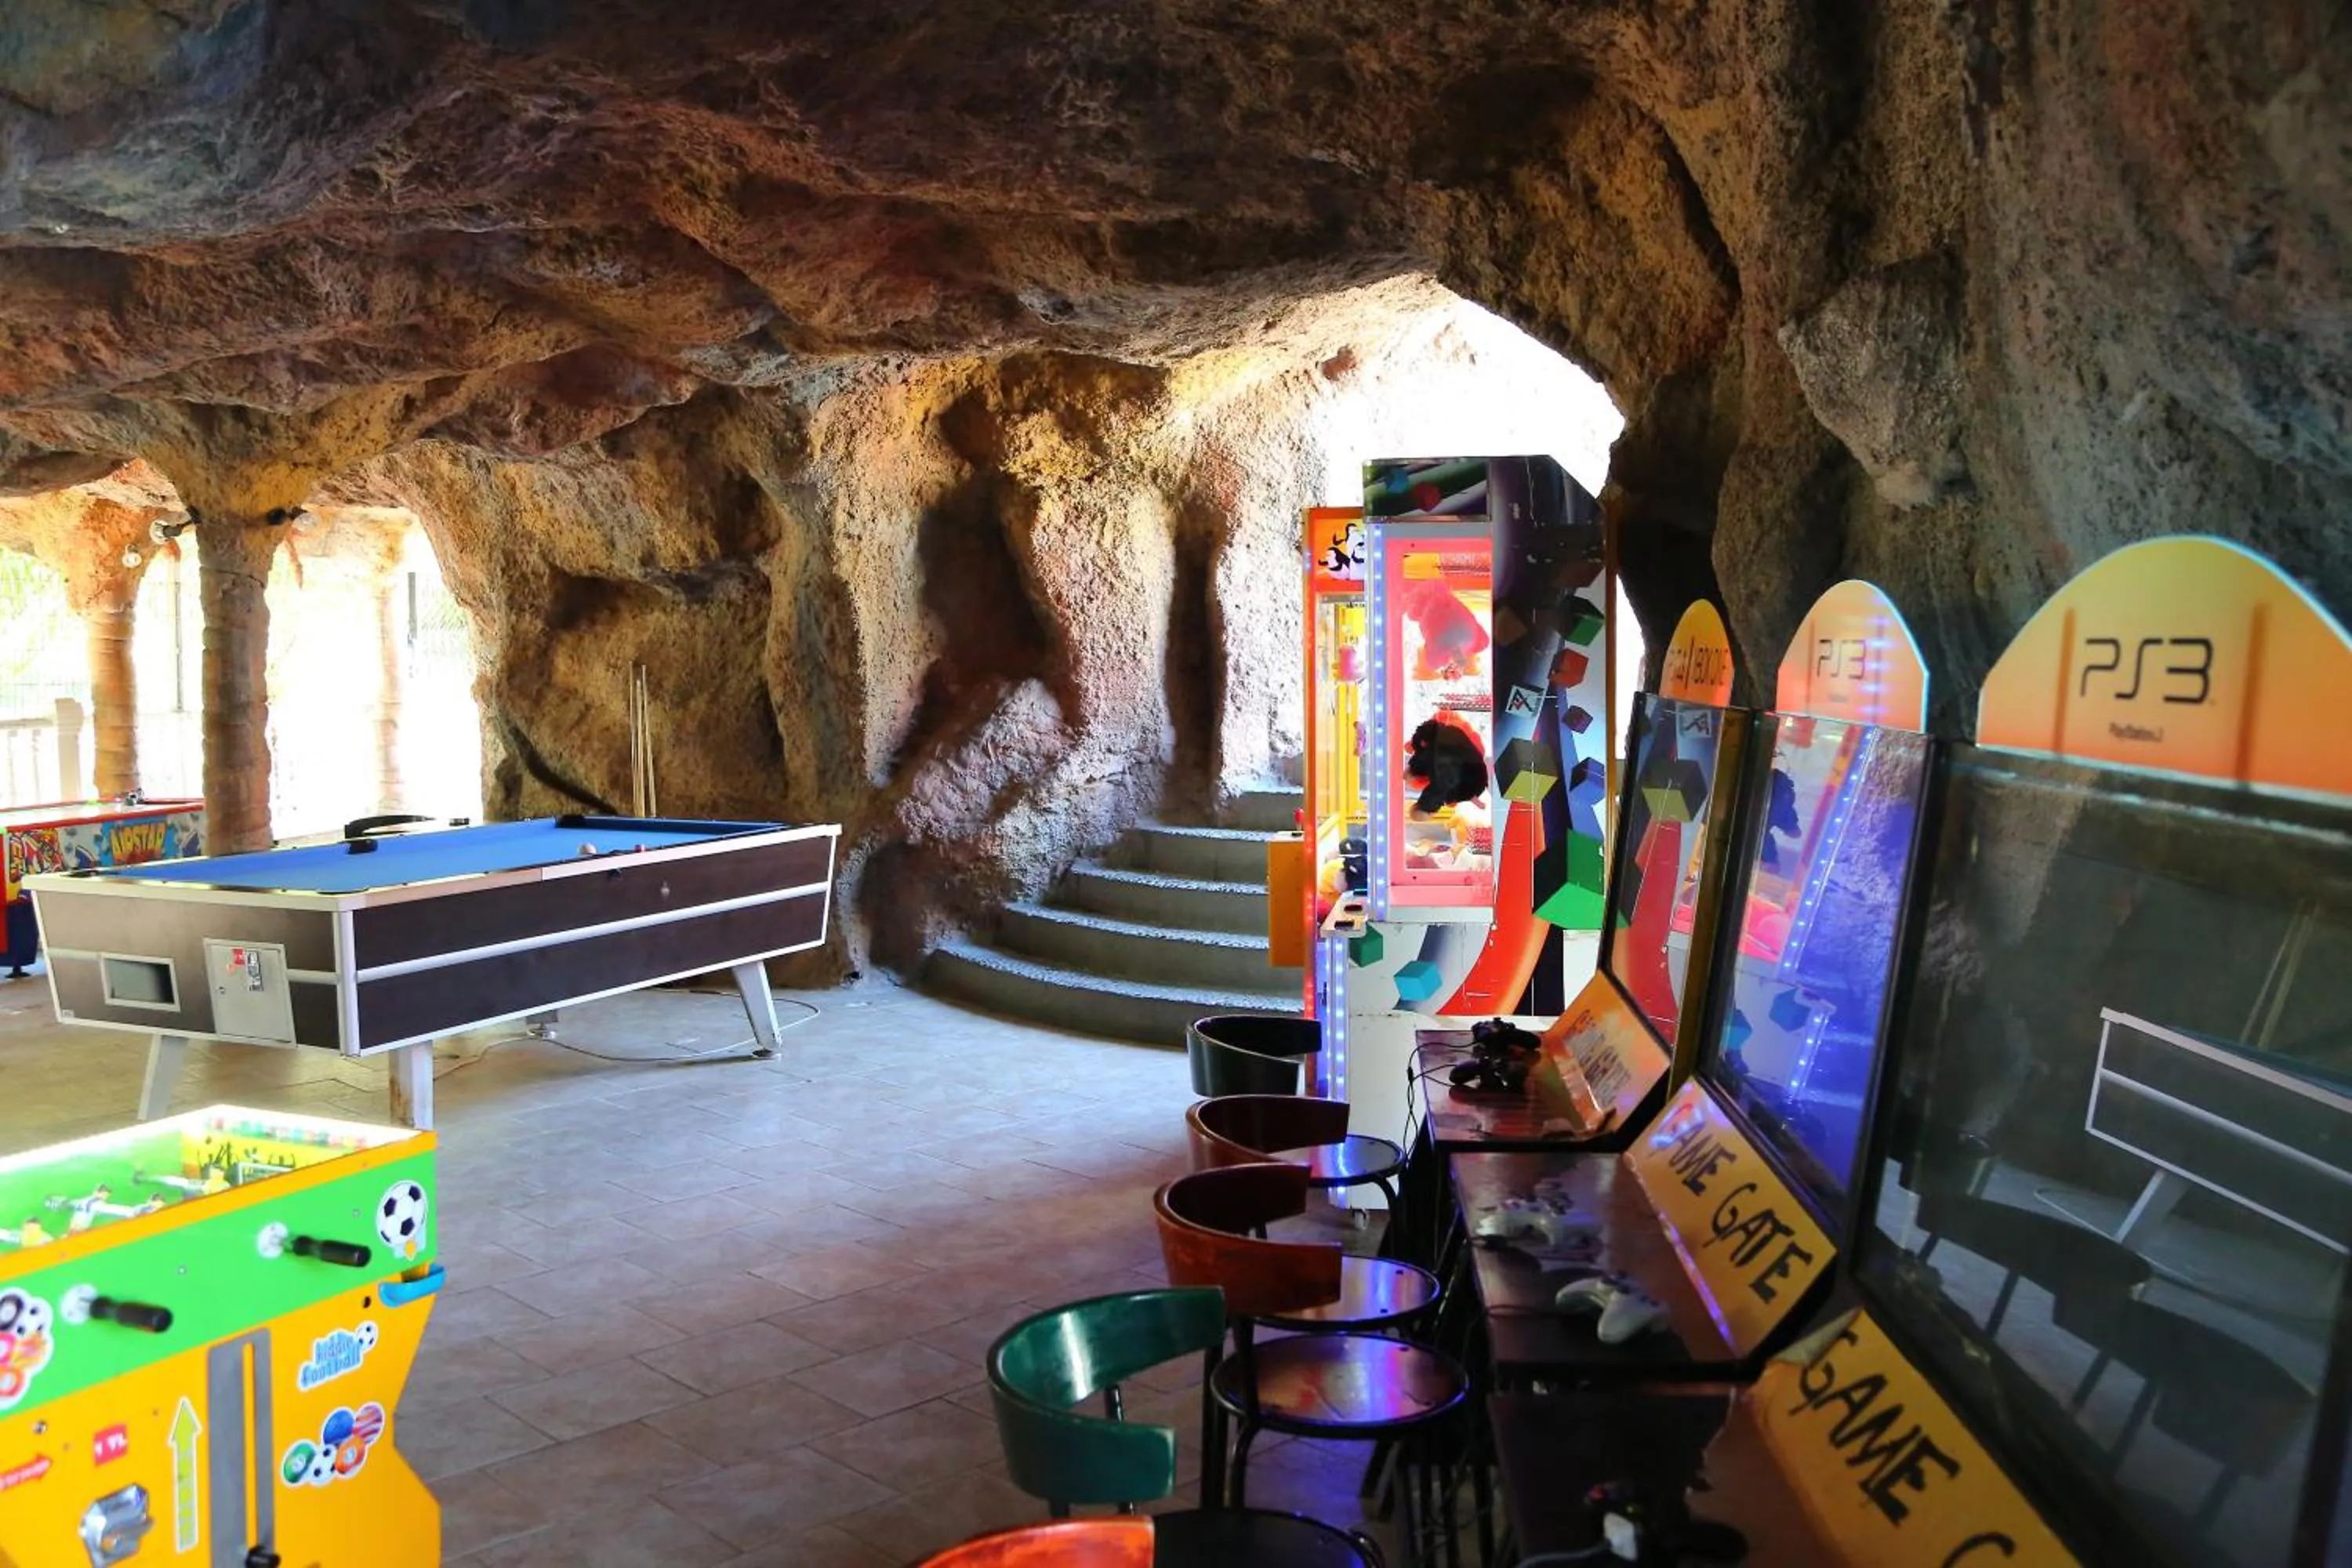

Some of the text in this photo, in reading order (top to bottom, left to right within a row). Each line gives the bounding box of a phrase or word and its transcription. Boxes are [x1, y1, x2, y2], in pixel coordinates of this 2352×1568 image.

[1817, 639, 1866, 680] PS3
[2080, 637, 2214, 704] PS3
[1702, 1182, 1813, 1305] GATE
[1789, 1330, 1962, 1529] GAME
